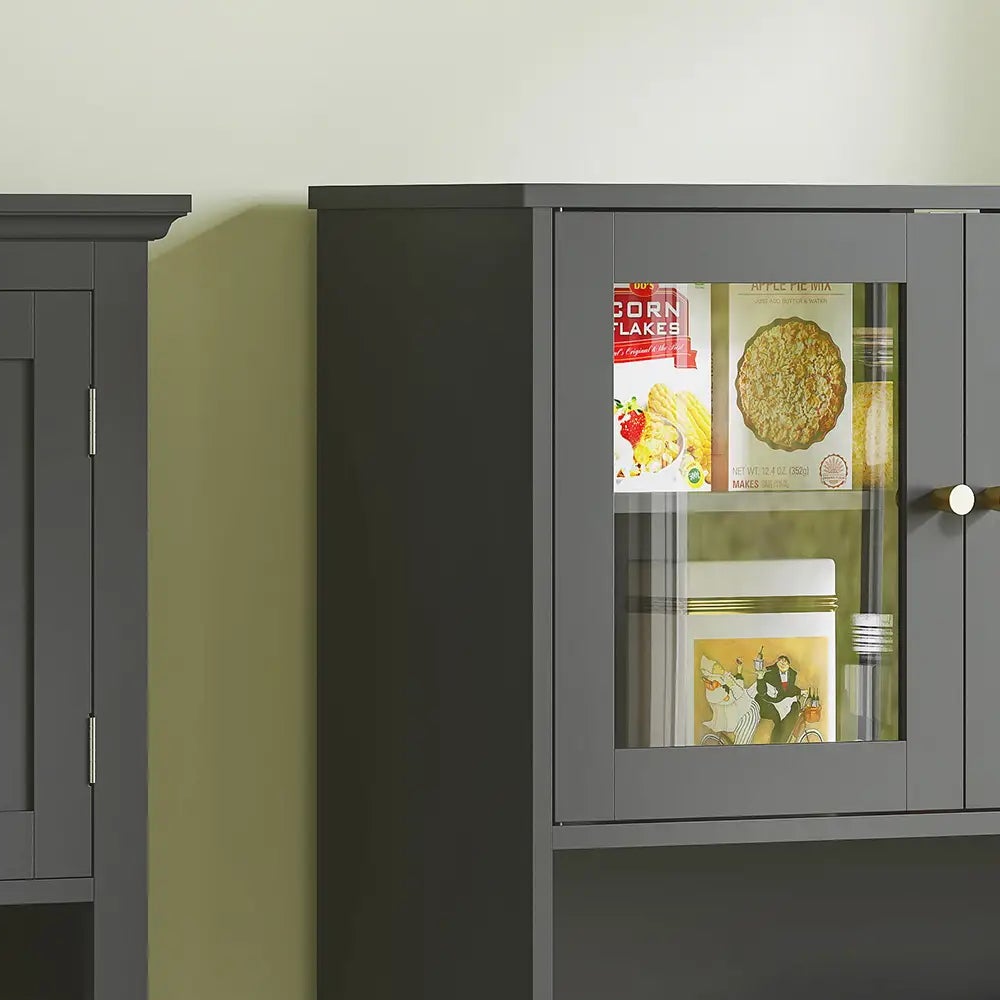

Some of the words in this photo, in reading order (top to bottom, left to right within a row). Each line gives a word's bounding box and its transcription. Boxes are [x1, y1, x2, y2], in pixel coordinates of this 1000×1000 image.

[751, 282, 787, 291] APPLE
[790, 282, 808, 291] PIE
[810, 282, 832, 291] MIX
[613, 301, 680, 318] CORN
[732, 466, 746, 476] NET
[789, 466, 810, 477] (352g)
[732, 480, 759, 489] MAKES
